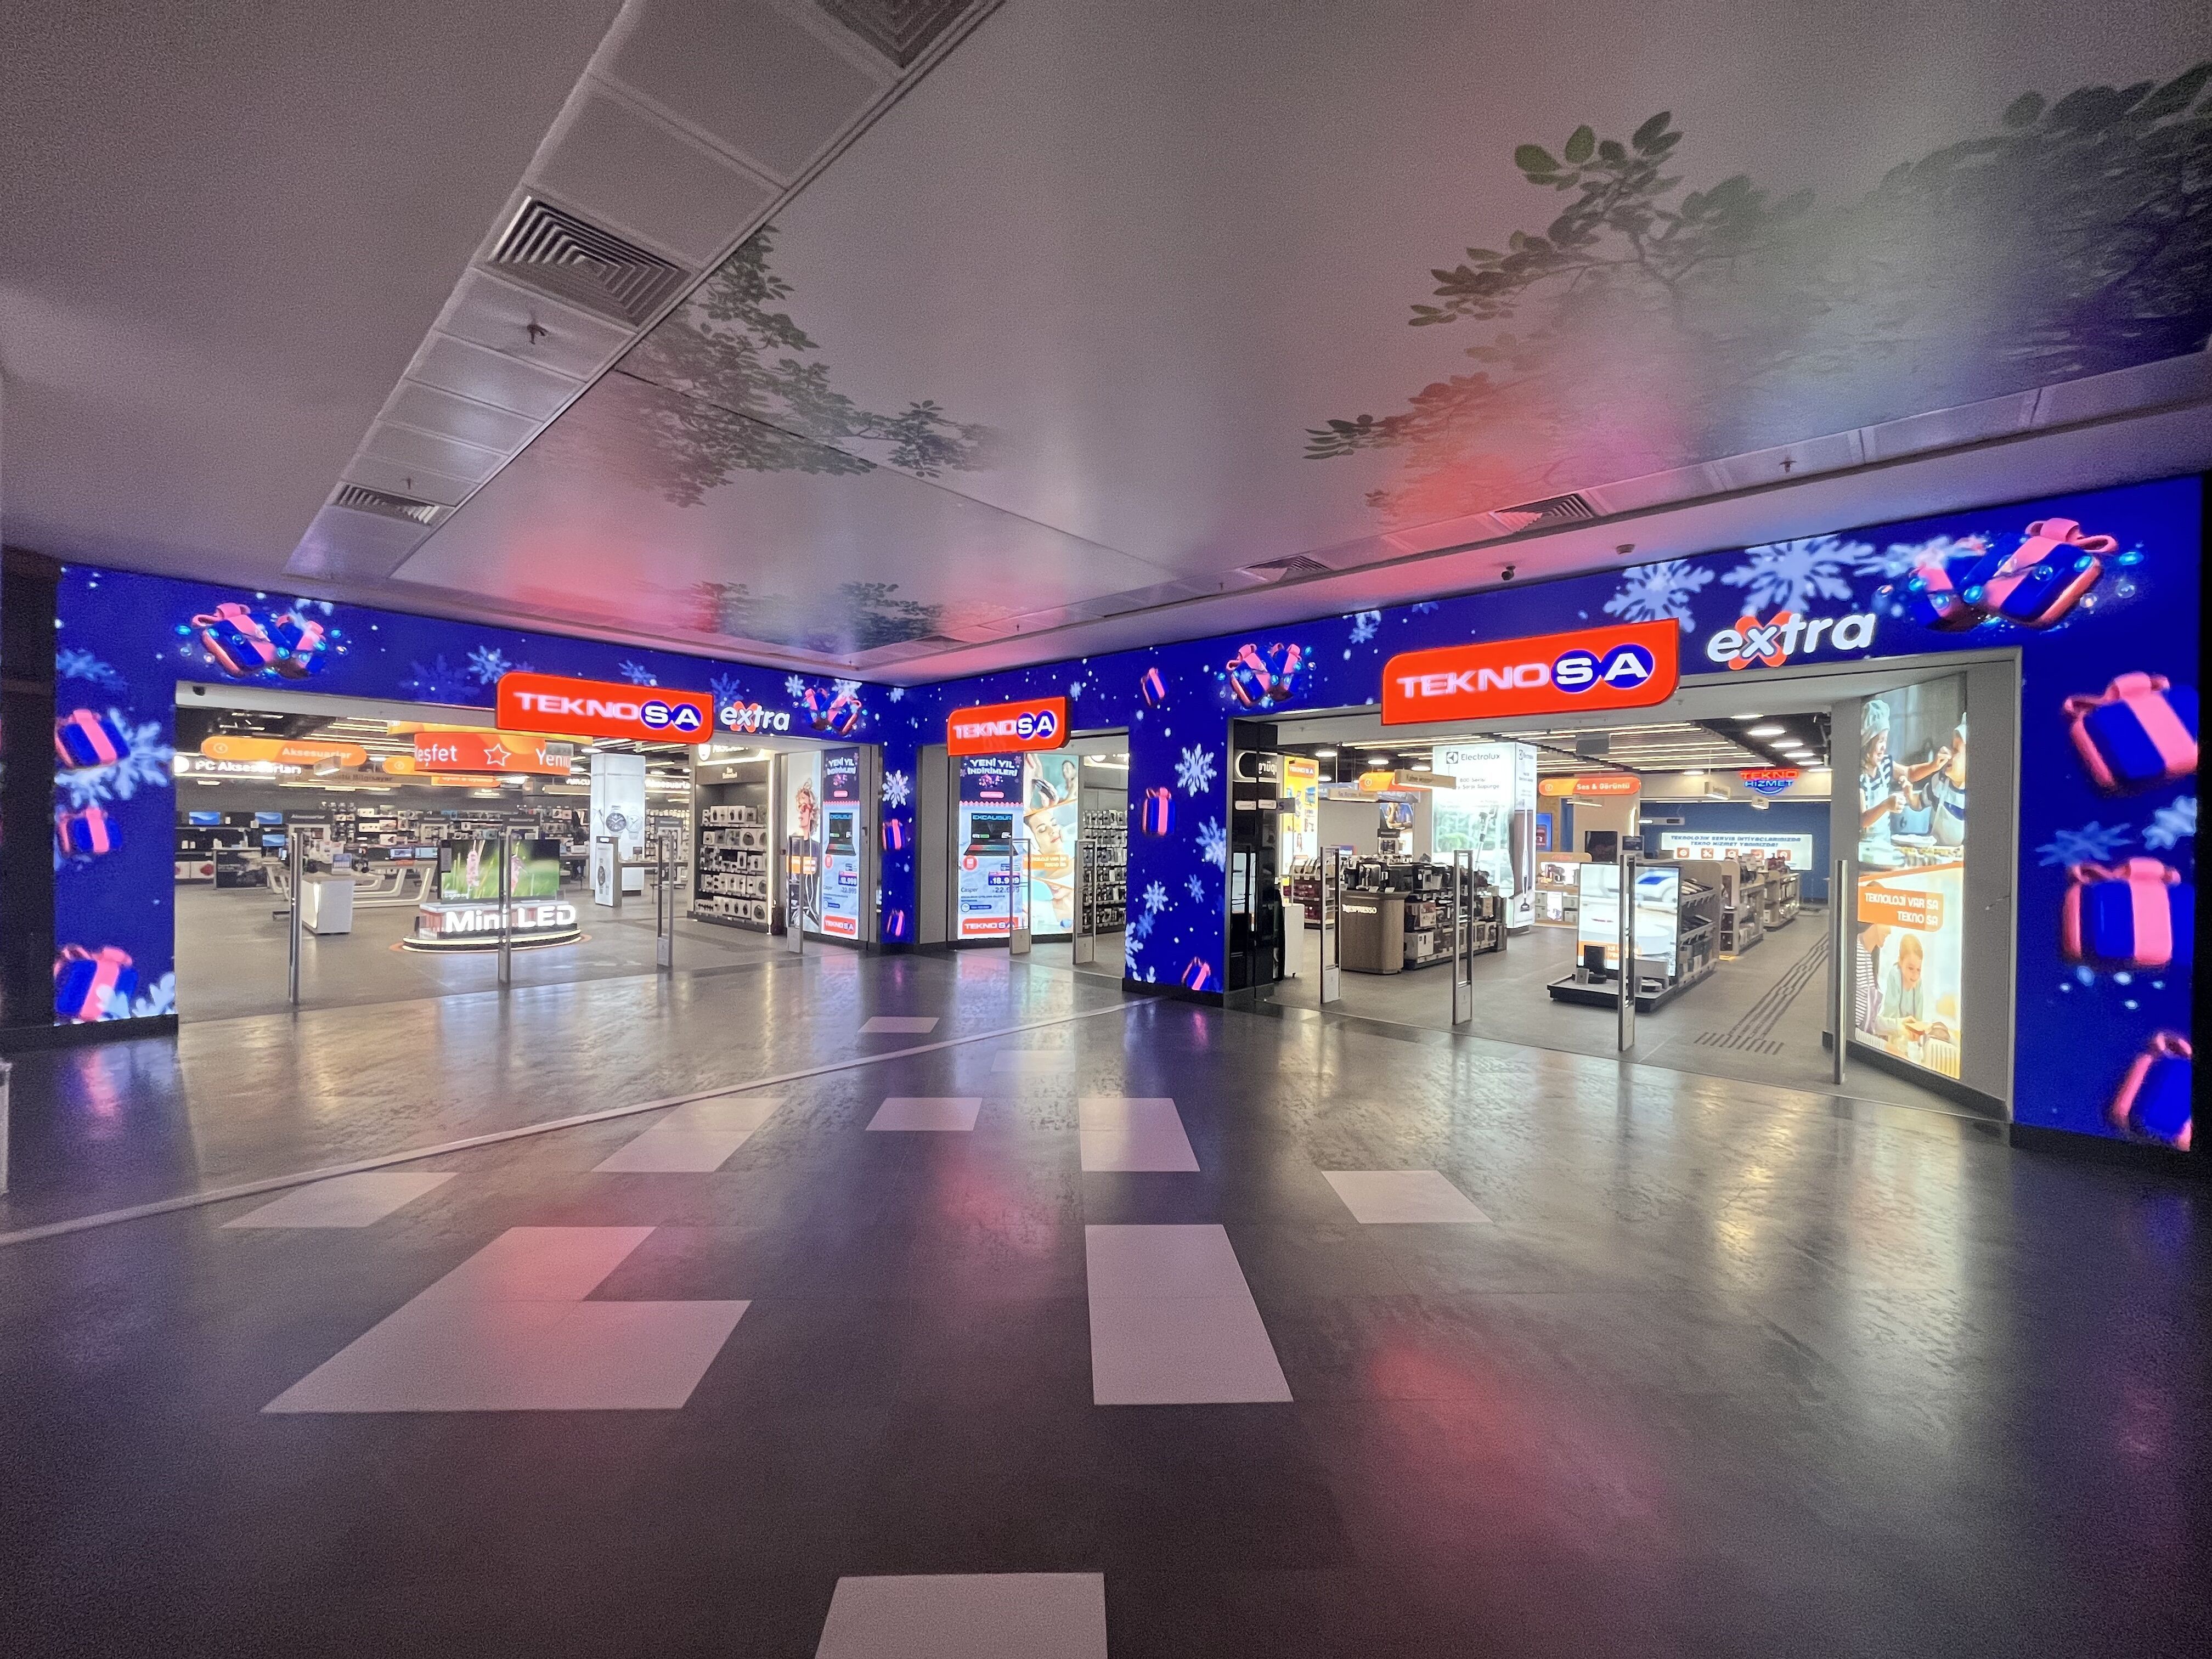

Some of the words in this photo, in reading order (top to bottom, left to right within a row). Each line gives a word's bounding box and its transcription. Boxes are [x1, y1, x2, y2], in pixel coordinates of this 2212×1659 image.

[1707, 612, 1875, 665] extra
[1396, 652, 1649, 698] TEKNOSA
[513, 692, 700, 727] TEKNOSA
[720, 704, 790, 731] extra
[953, 715, 1053, 739] TEKNOSA
[282, 747, 352, 759] Aksesuarlar
[1461, 753, 1500, 761] Electrolux
[195, 760, 215, 771] PC
[218, 761, 302, 774] Aksesrları
[828, 757, 844, 767] YENİ
[969, 757, 996, 768] YENİ
[997, 759, 1015, 769] YIL
[967, 766, 1018, 777] İNDİRİMLERİ
[1740, 770, 1800, 780] TEKNO
[1864, 893, 1906, 906] TEKNOLOJİ
[1908, 896, 1925, 909] VAR
[1926, 899, 1939, 910] SA
[445, 910, 507, 933] Mini
[518, 905, 577, 928] LED
[1897, 911, 1925, 923] TEKNO
[1926, 915, 1938, 926] SA
